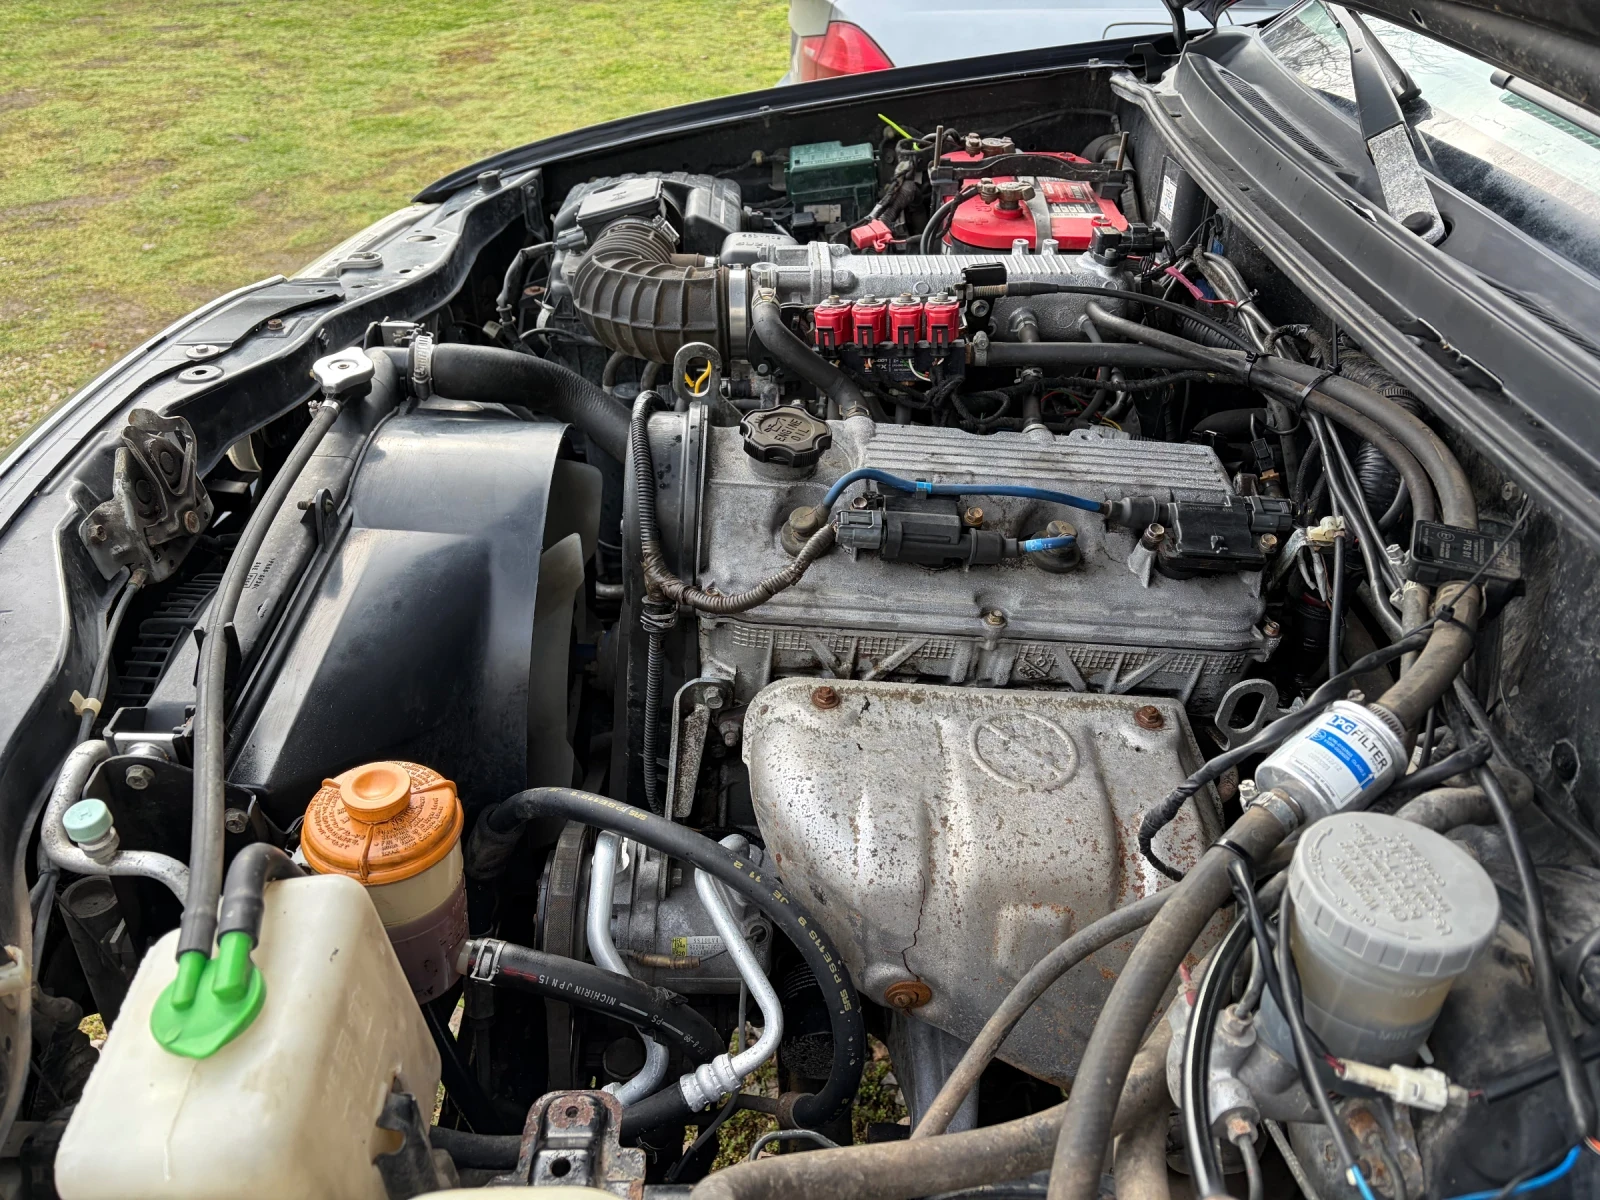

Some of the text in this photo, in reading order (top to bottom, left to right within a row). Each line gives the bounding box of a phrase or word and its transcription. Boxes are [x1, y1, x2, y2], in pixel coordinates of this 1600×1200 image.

[774, 418, 802, 442] ENGINE
[790, 429, 810, 441] OIL
[1462, 539, 1472, 550] PTS
[1327, 713, 1356, 734] LPG
[1350, 728, 1388, 770] FILTER
[733, 860, 744, 869] 2
[749, 871, 761, 883] 11
[772, 889, 790, 904] JE
[808, 930, 842, 984] PSE11S
[574, 985, 617, 1006] NICHIRIN
[651, 1014, 663, 1026] PS
